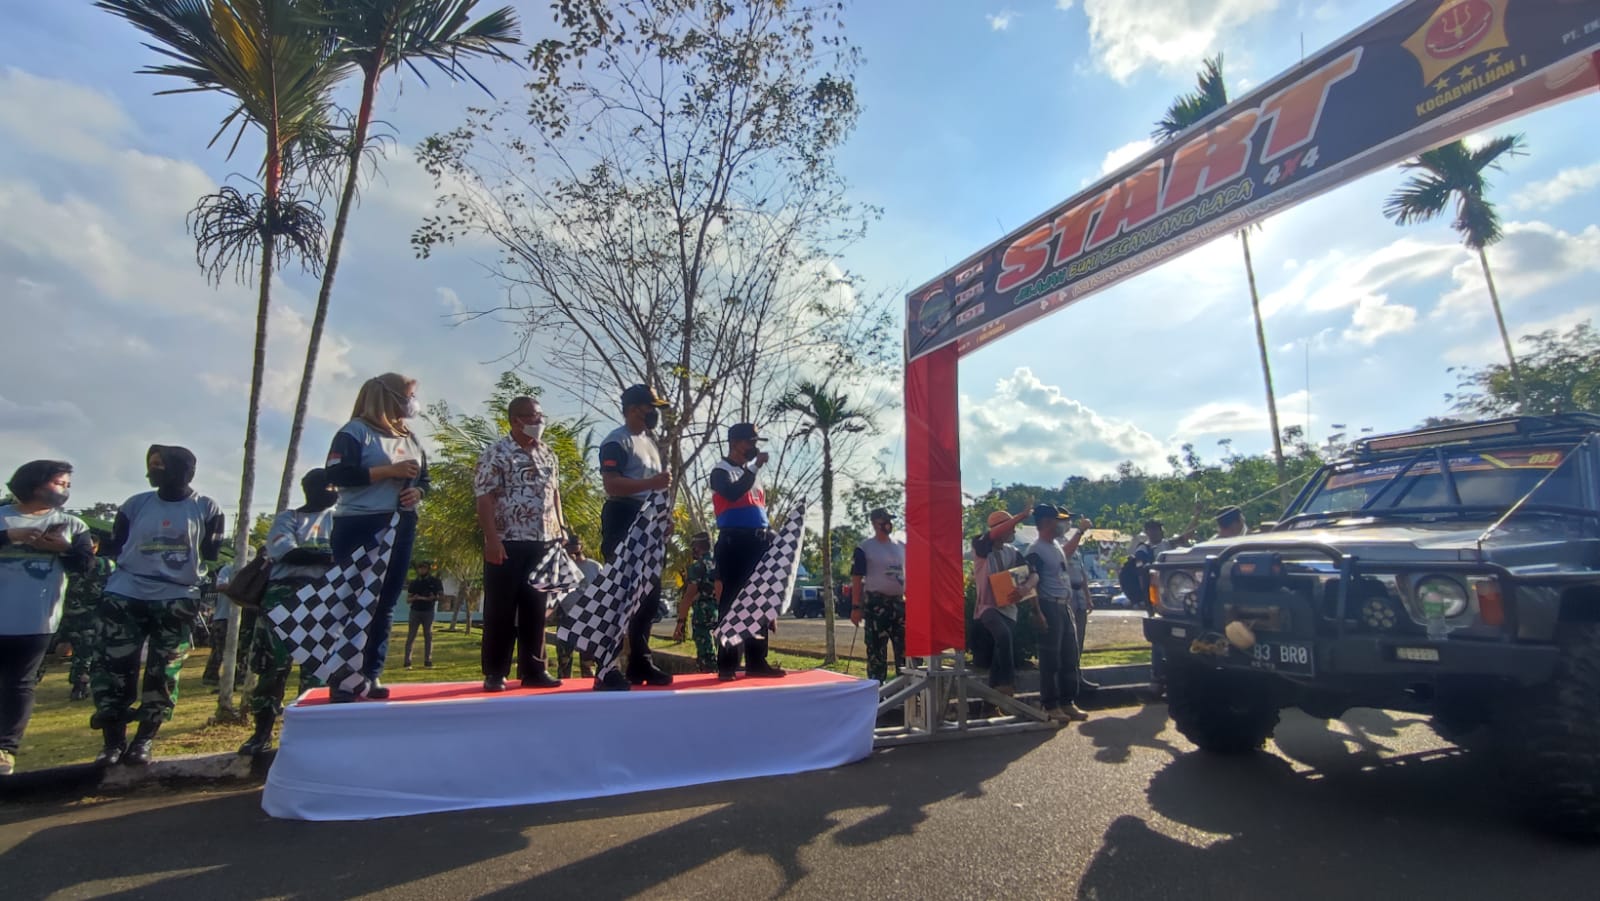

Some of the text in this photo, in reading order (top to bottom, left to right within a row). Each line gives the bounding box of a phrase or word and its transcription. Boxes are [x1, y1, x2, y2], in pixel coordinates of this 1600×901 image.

[1416, 60, 1516, 117] KOGABWILHAN
[995, 46, 1364, 293] START
[1067, 252, 1101, 280] BUMI
[1101, 206, 1198, 264] SEGANTANG
[1197, 177, 1255, 219] LADA
